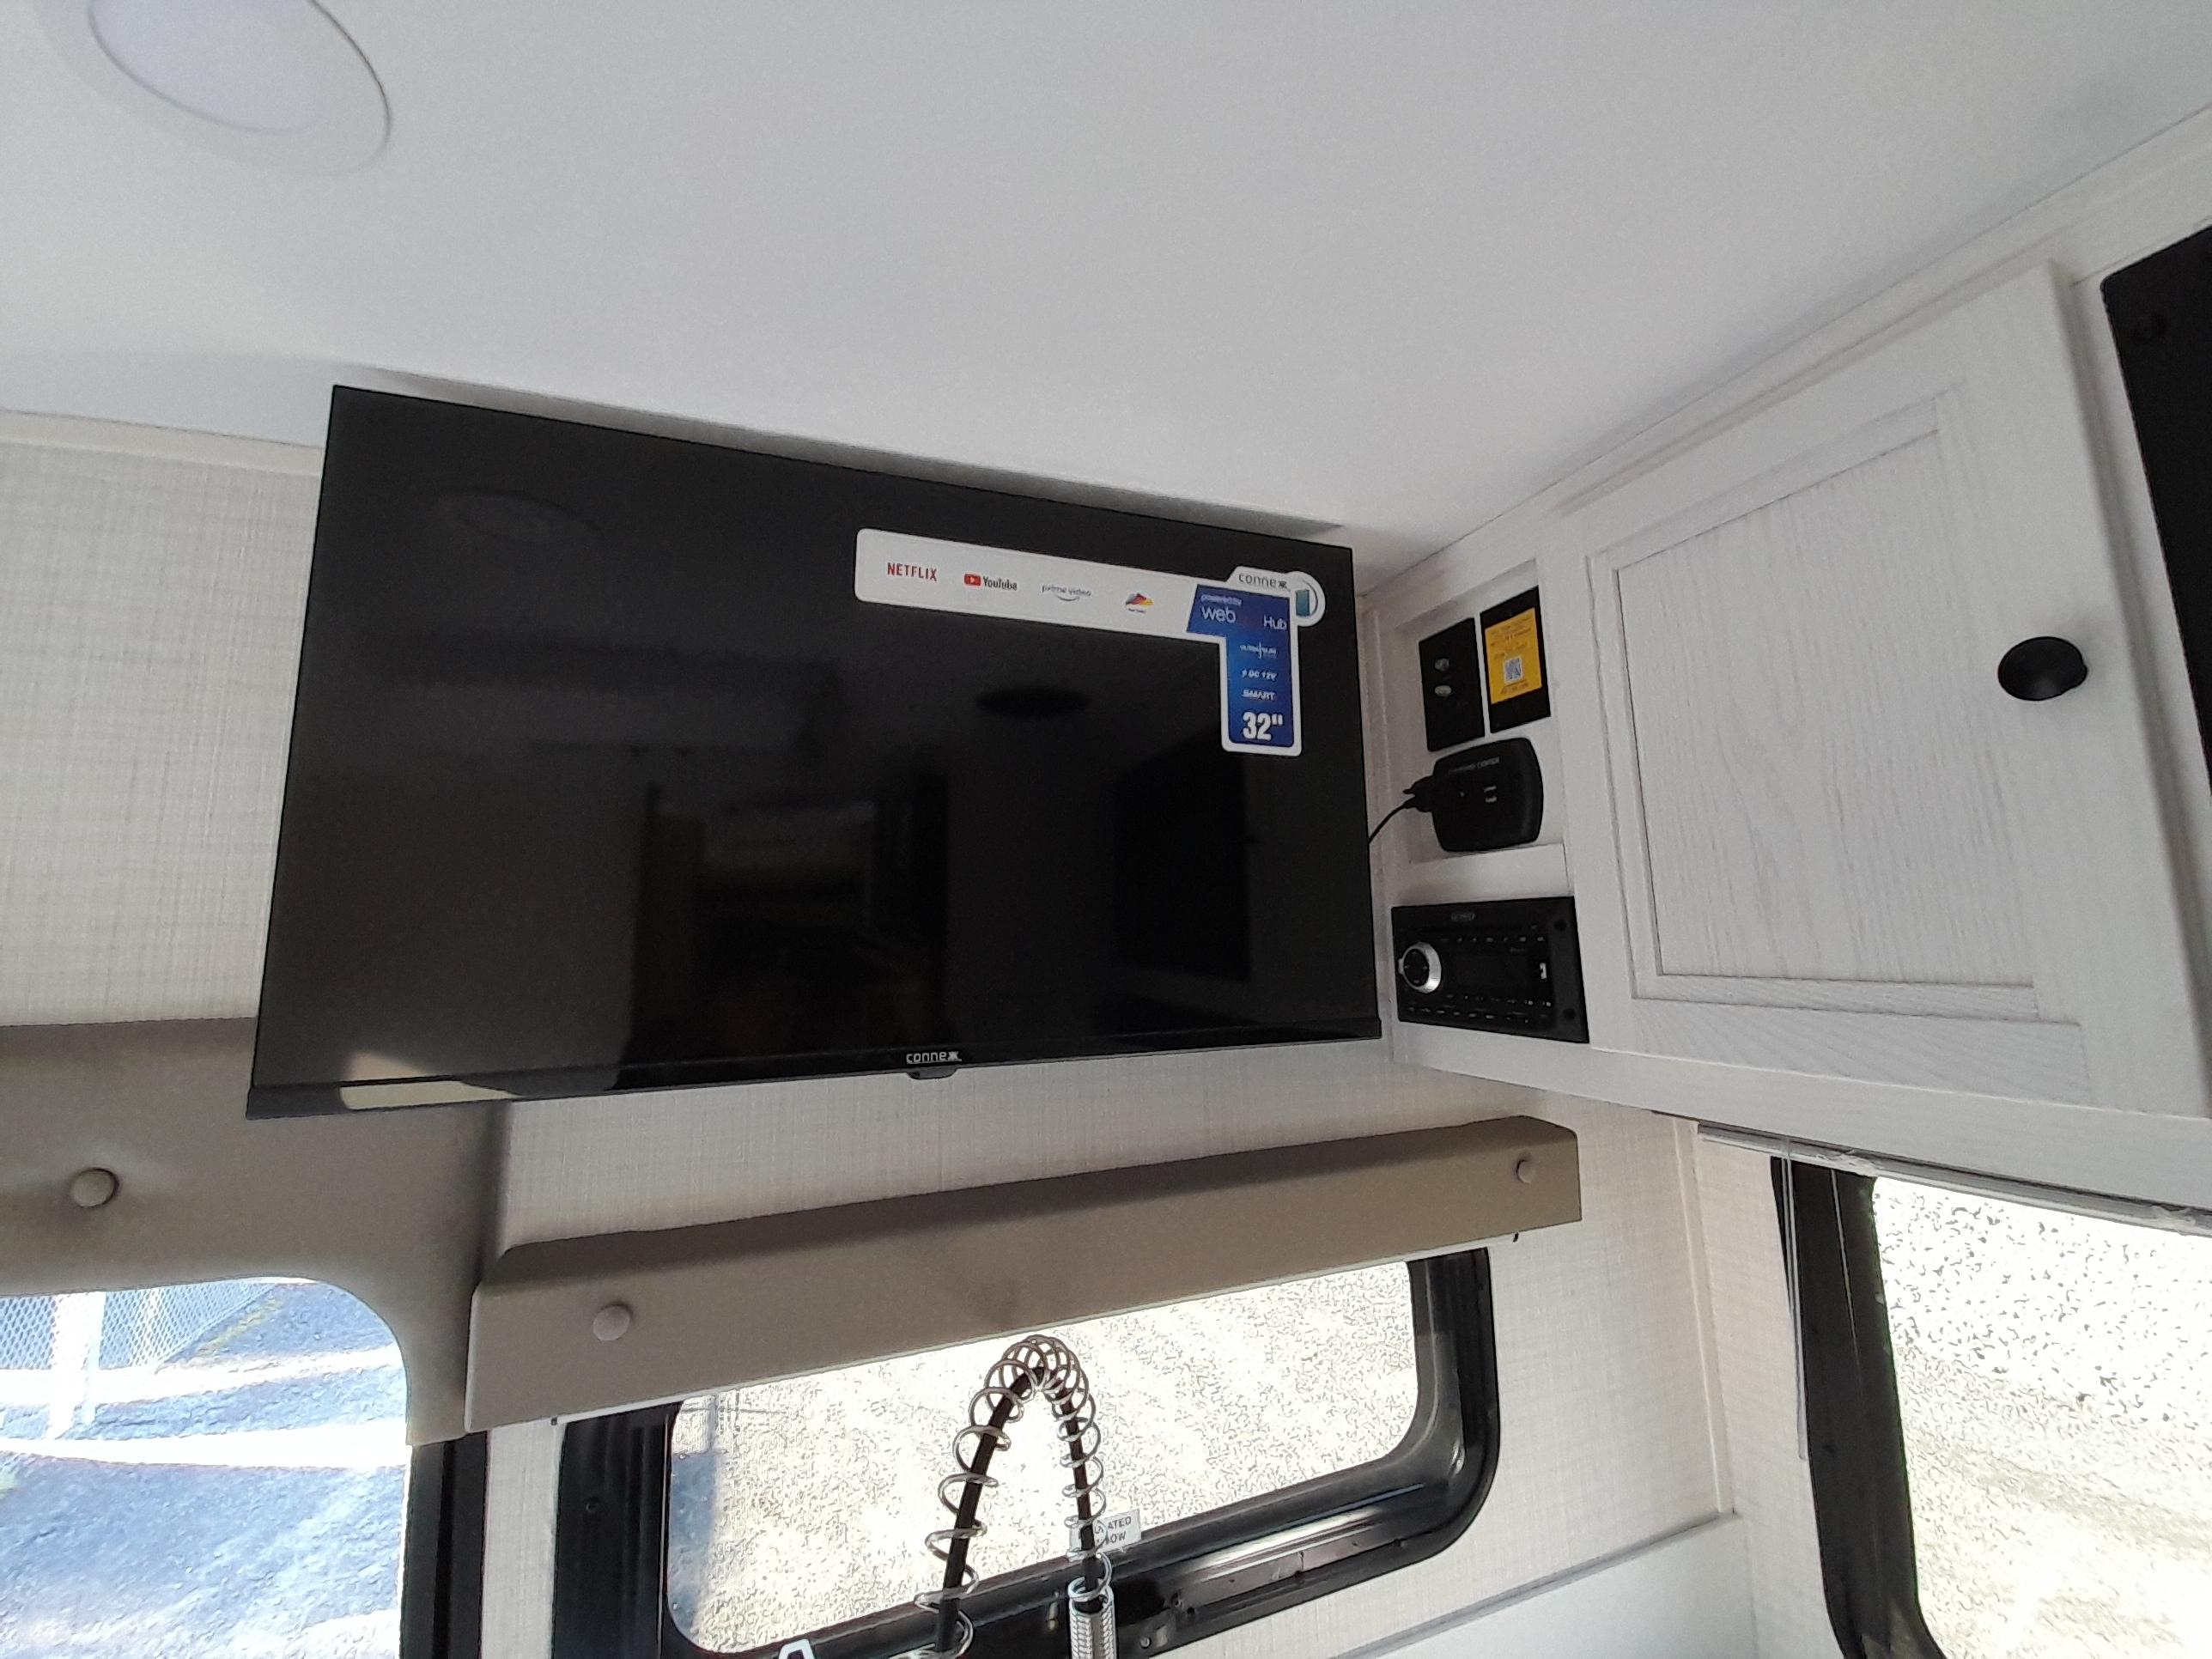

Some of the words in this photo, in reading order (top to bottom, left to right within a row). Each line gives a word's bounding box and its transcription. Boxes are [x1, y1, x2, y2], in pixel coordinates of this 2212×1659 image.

[887, 562, 938, 582] NETFLIX
[982, 576, 1018, 592] YouTube
[1201, 605, 1237, 624] web
[1263, 614, 1287, 630] Hub
[1242, 711, 1284, 742] 32"
